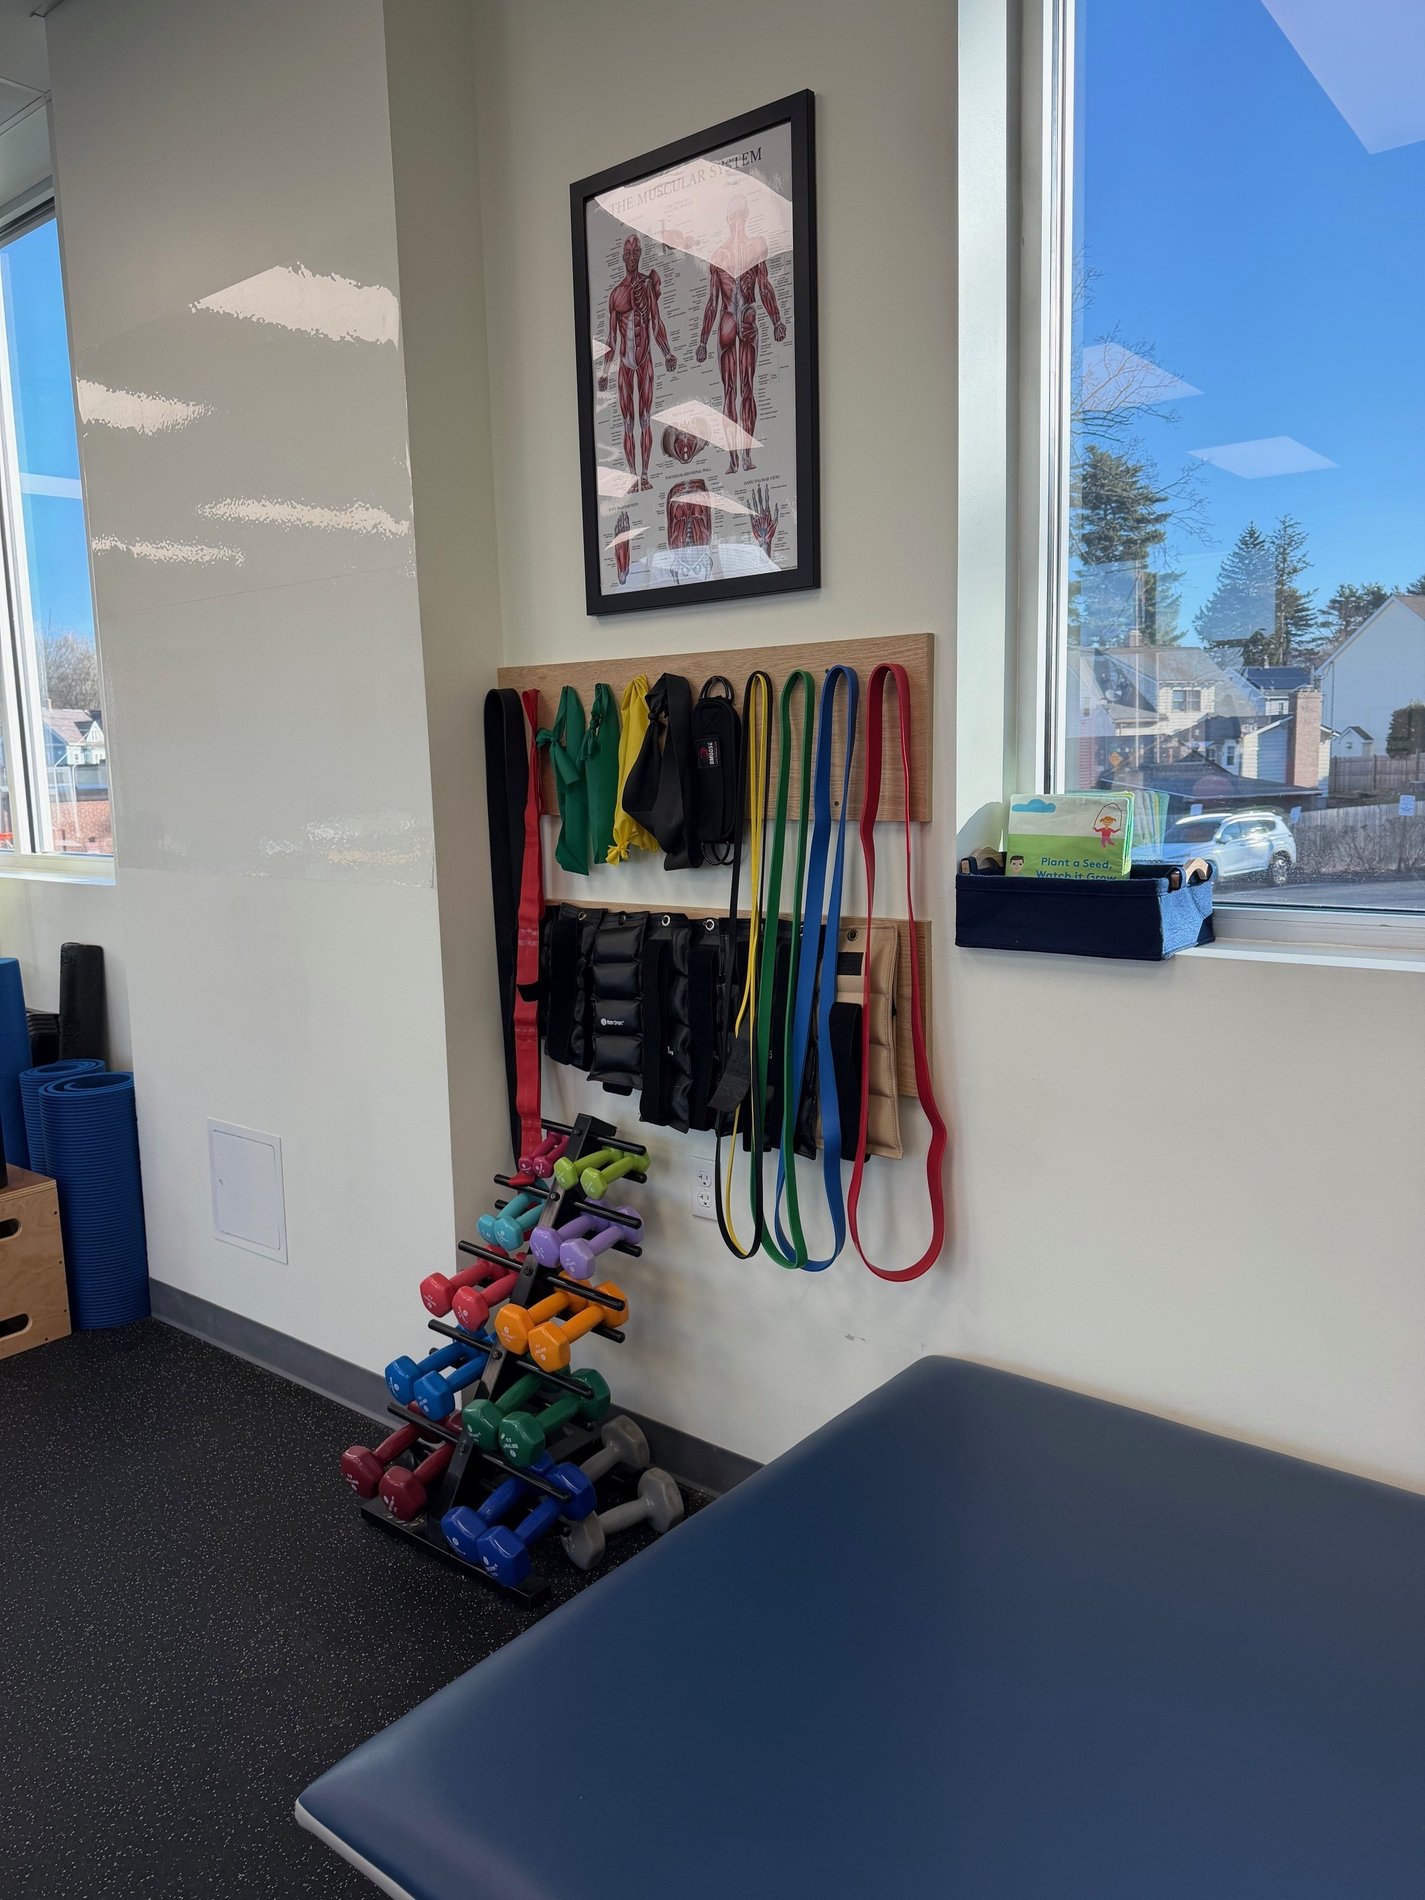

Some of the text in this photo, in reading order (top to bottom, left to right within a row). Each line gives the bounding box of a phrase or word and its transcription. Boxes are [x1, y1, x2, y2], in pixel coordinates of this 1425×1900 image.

[608, 196, 634, 214] THE
[637, 169, 706, 206] MUSCULAR
[710, 147, 762, 177] SYSTEM
[1041, 857, 1070, 867] Plant
[1083, 859, 1112, 870] Seed,
[1036, 870, 1072, 879] Watch
[1075, 871, 1083, 879] it
